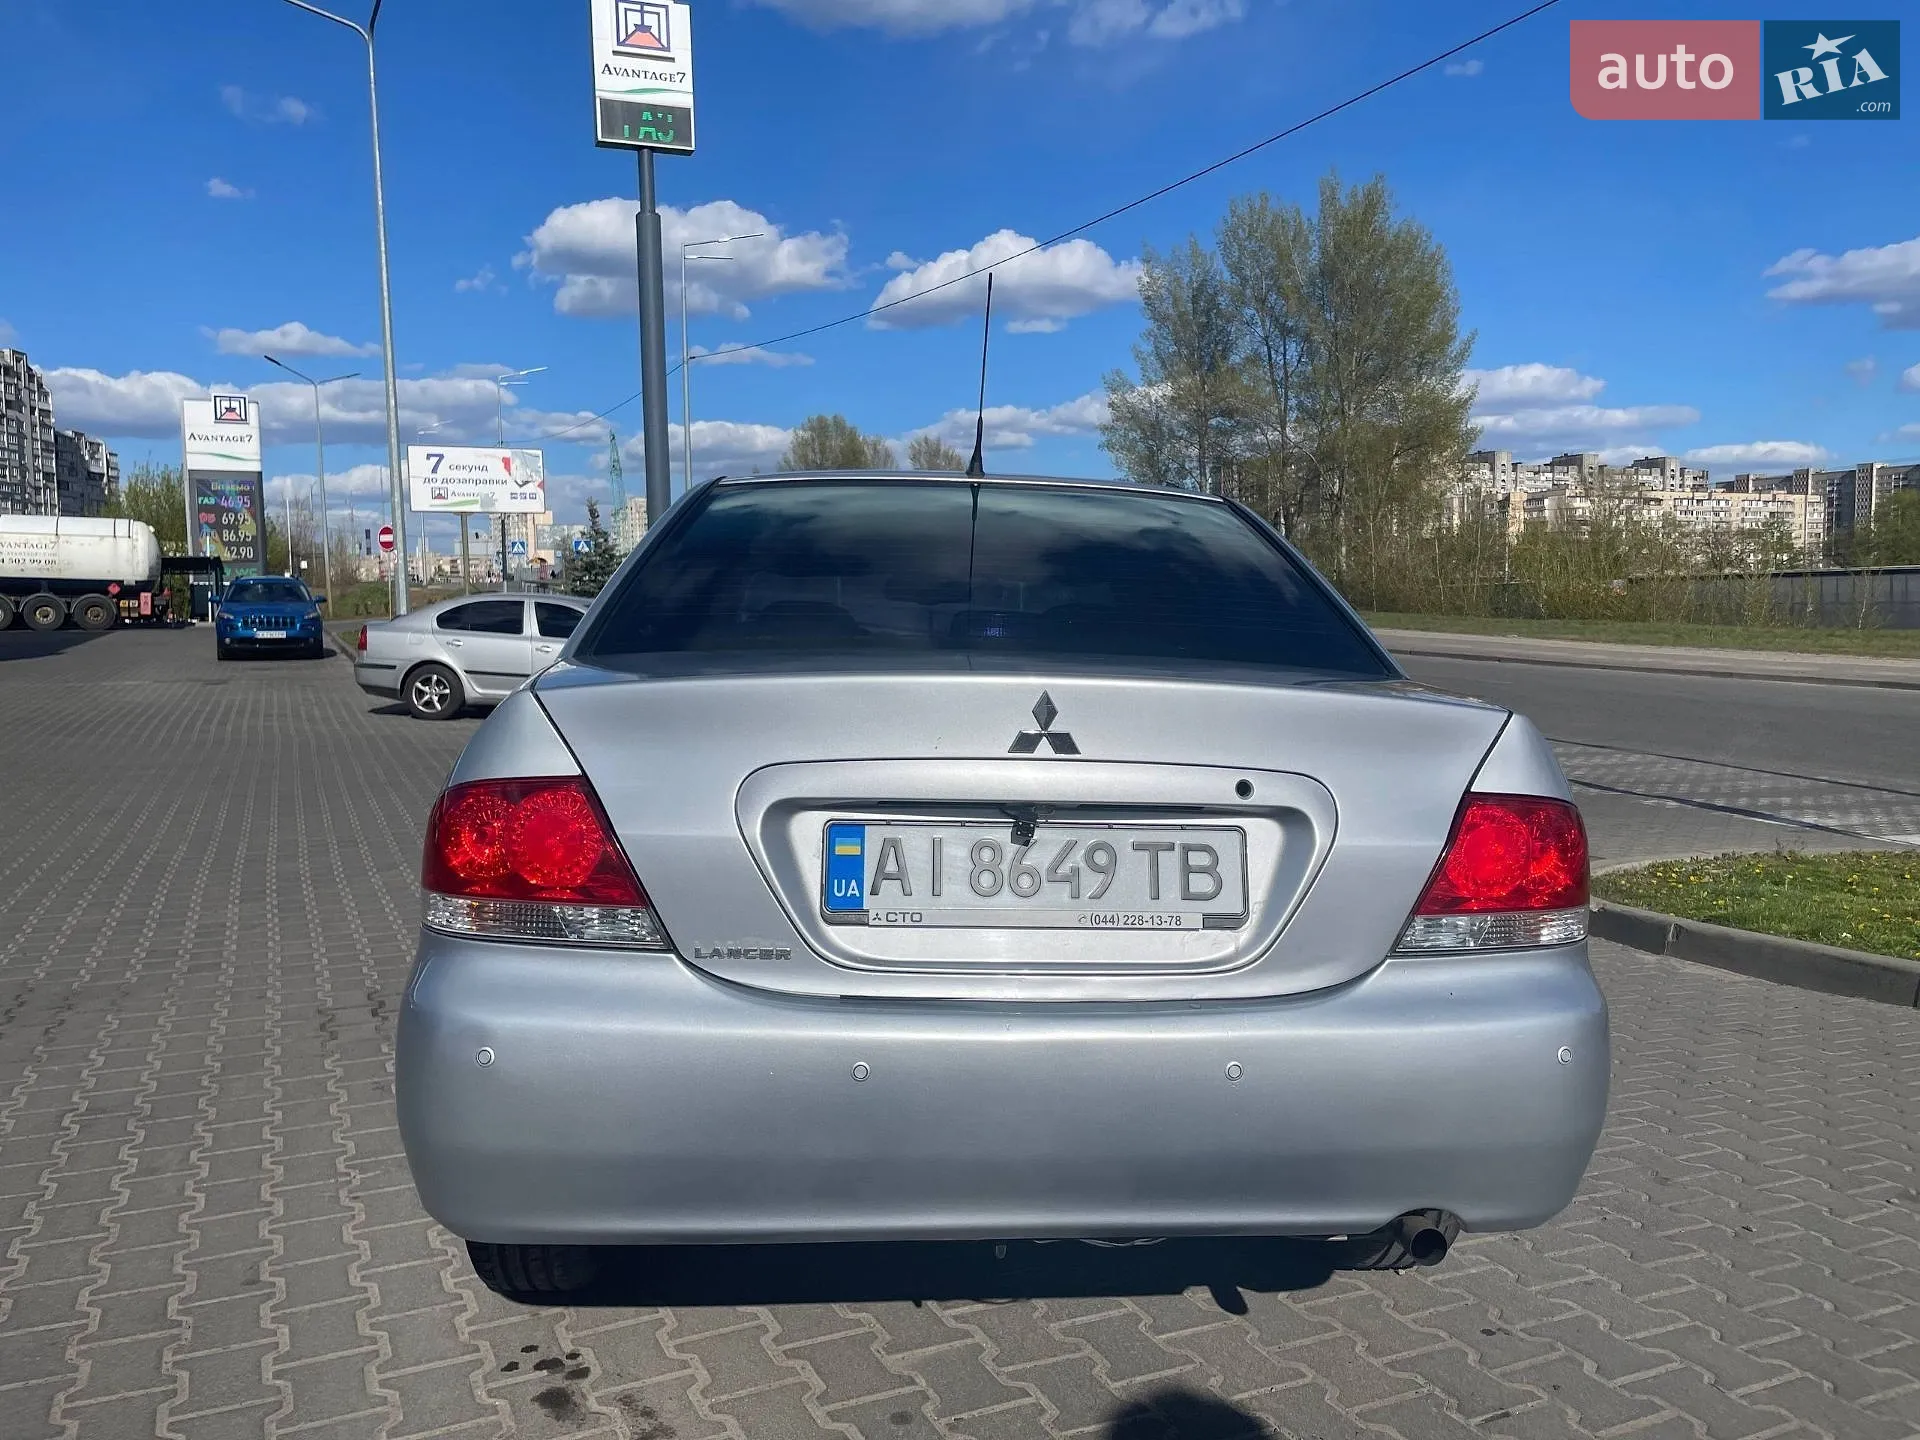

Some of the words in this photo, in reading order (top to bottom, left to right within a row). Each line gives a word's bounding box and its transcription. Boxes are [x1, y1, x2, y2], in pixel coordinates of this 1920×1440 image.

[601, 63, 686, 83] AVANTAGE7
[188, 432, 253, 443] AVANTAGE7
[426, 453, 445, 474] 7
[449, 464, 488, 473] секунд
[424, 477, 438, 485] до
[441, 477, 508, 487] дозаправки
[221, 512, 251, 525] 69.95
[222, 529, 252, 541] 86.95
[869, 837, 943, 897] AI
[969, 837, 1118, 900] 8649
[1132, 841, 1223, 901] TB
[833, 879, 860, 898] UA
[1089, 912, 1121, 927] (044)
[1122, 913, 1182, 927] 228-13-78
[694, 946, 792, 961] LANCER
